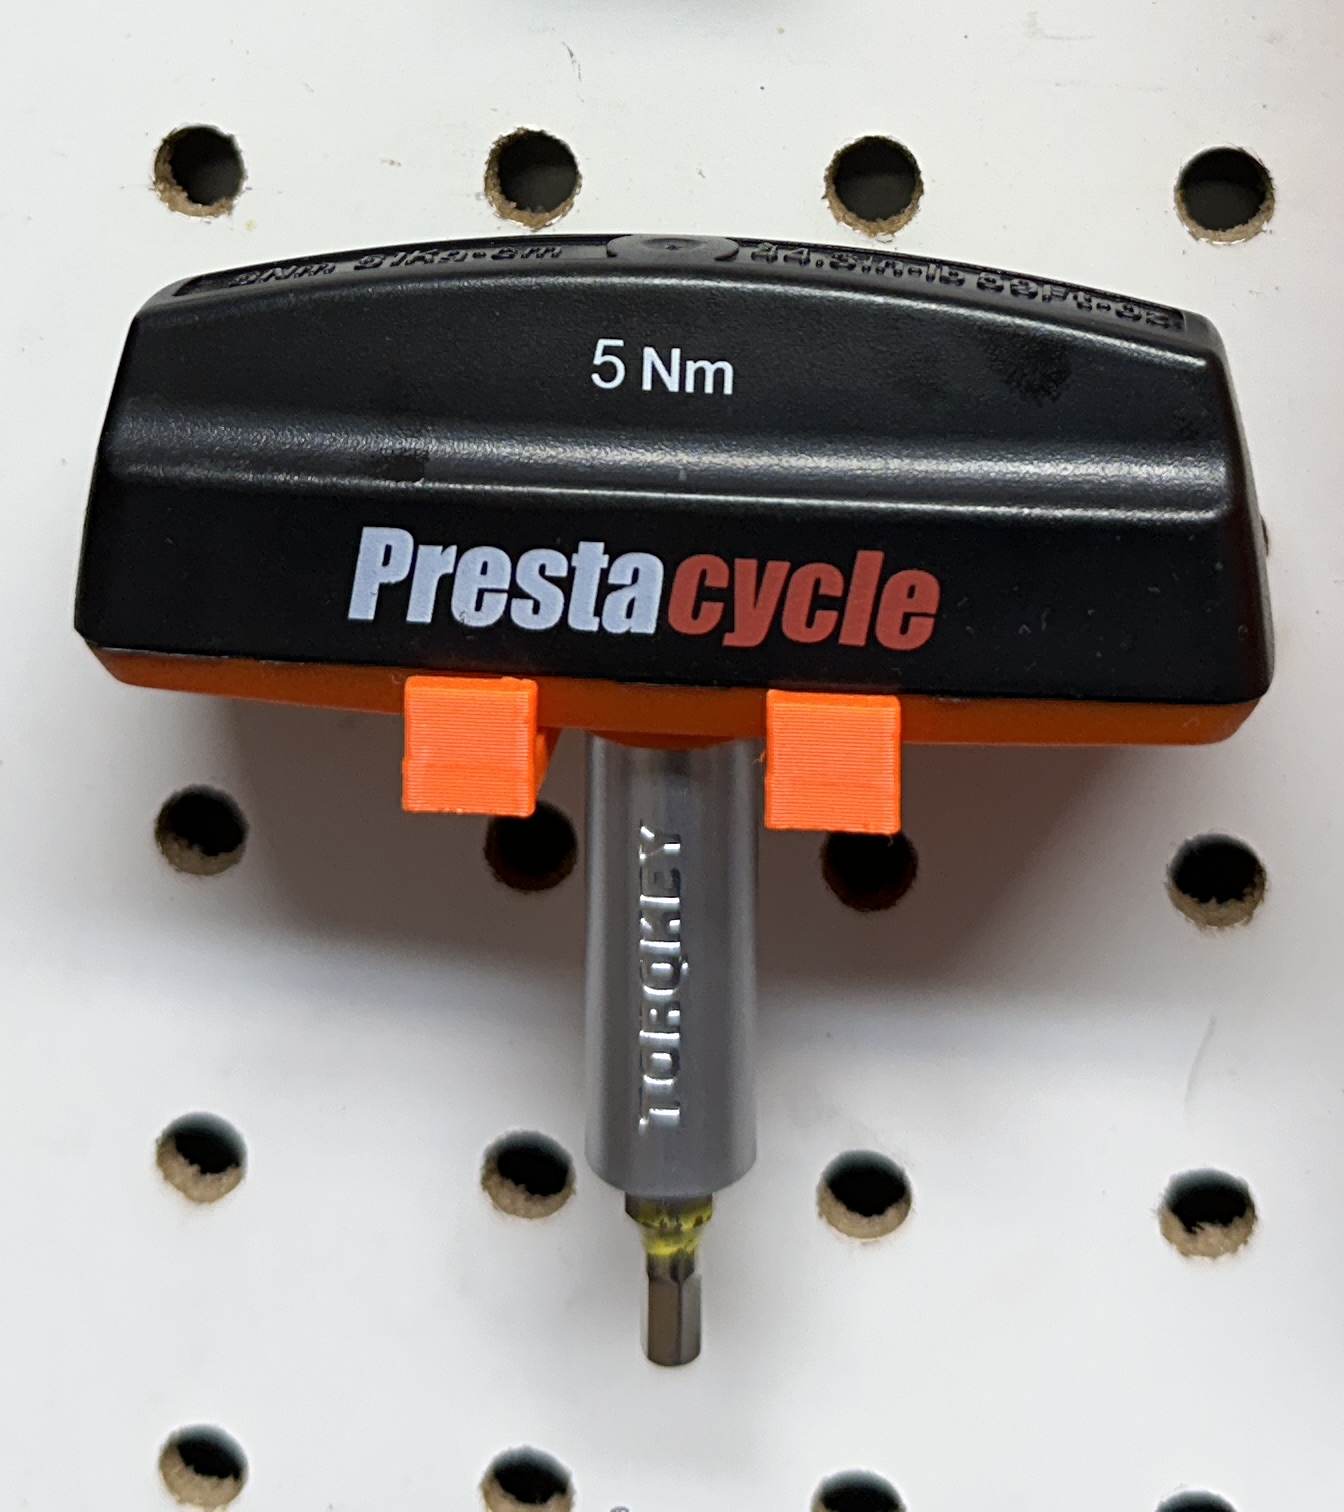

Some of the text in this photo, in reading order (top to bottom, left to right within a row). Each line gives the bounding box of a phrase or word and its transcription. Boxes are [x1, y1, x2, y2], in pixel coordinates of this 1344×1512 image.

[589, 338, 735, 395] 5 Nm
[347, 526, 942, 651] Prestacycle
[639, 820, 689, 1140] TORQKEY
